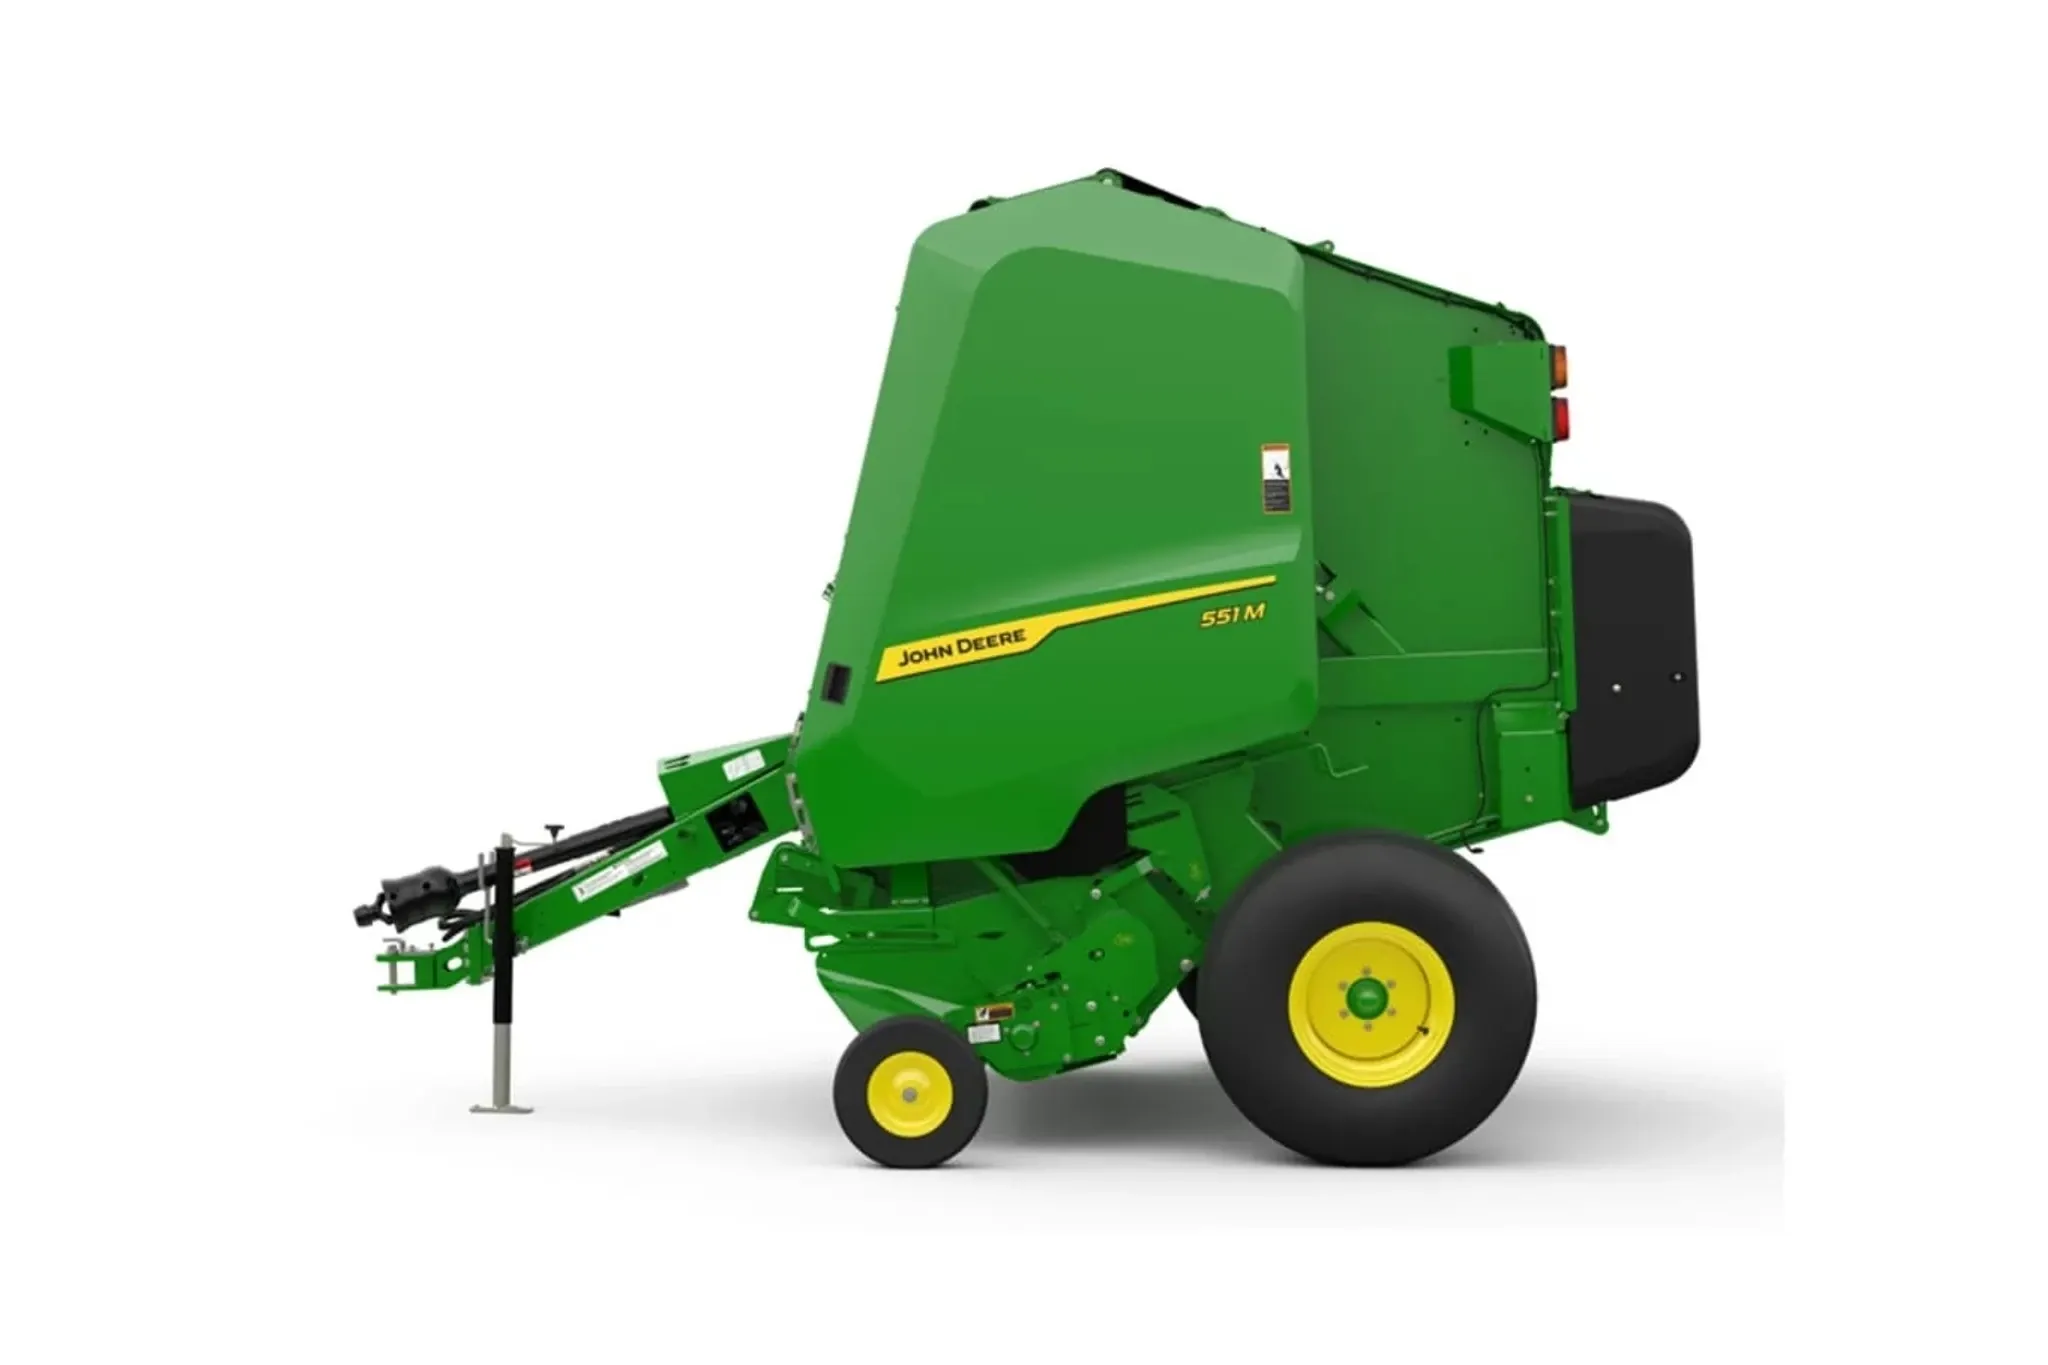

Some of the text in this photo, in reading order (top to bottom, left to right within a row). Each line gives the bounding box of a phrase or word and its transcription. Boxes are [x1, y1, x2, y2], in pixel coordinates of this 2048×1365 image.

[1199, 602, 1267, 628] 551 M
[898, 628, 1027, 668] JOHN DEERE
